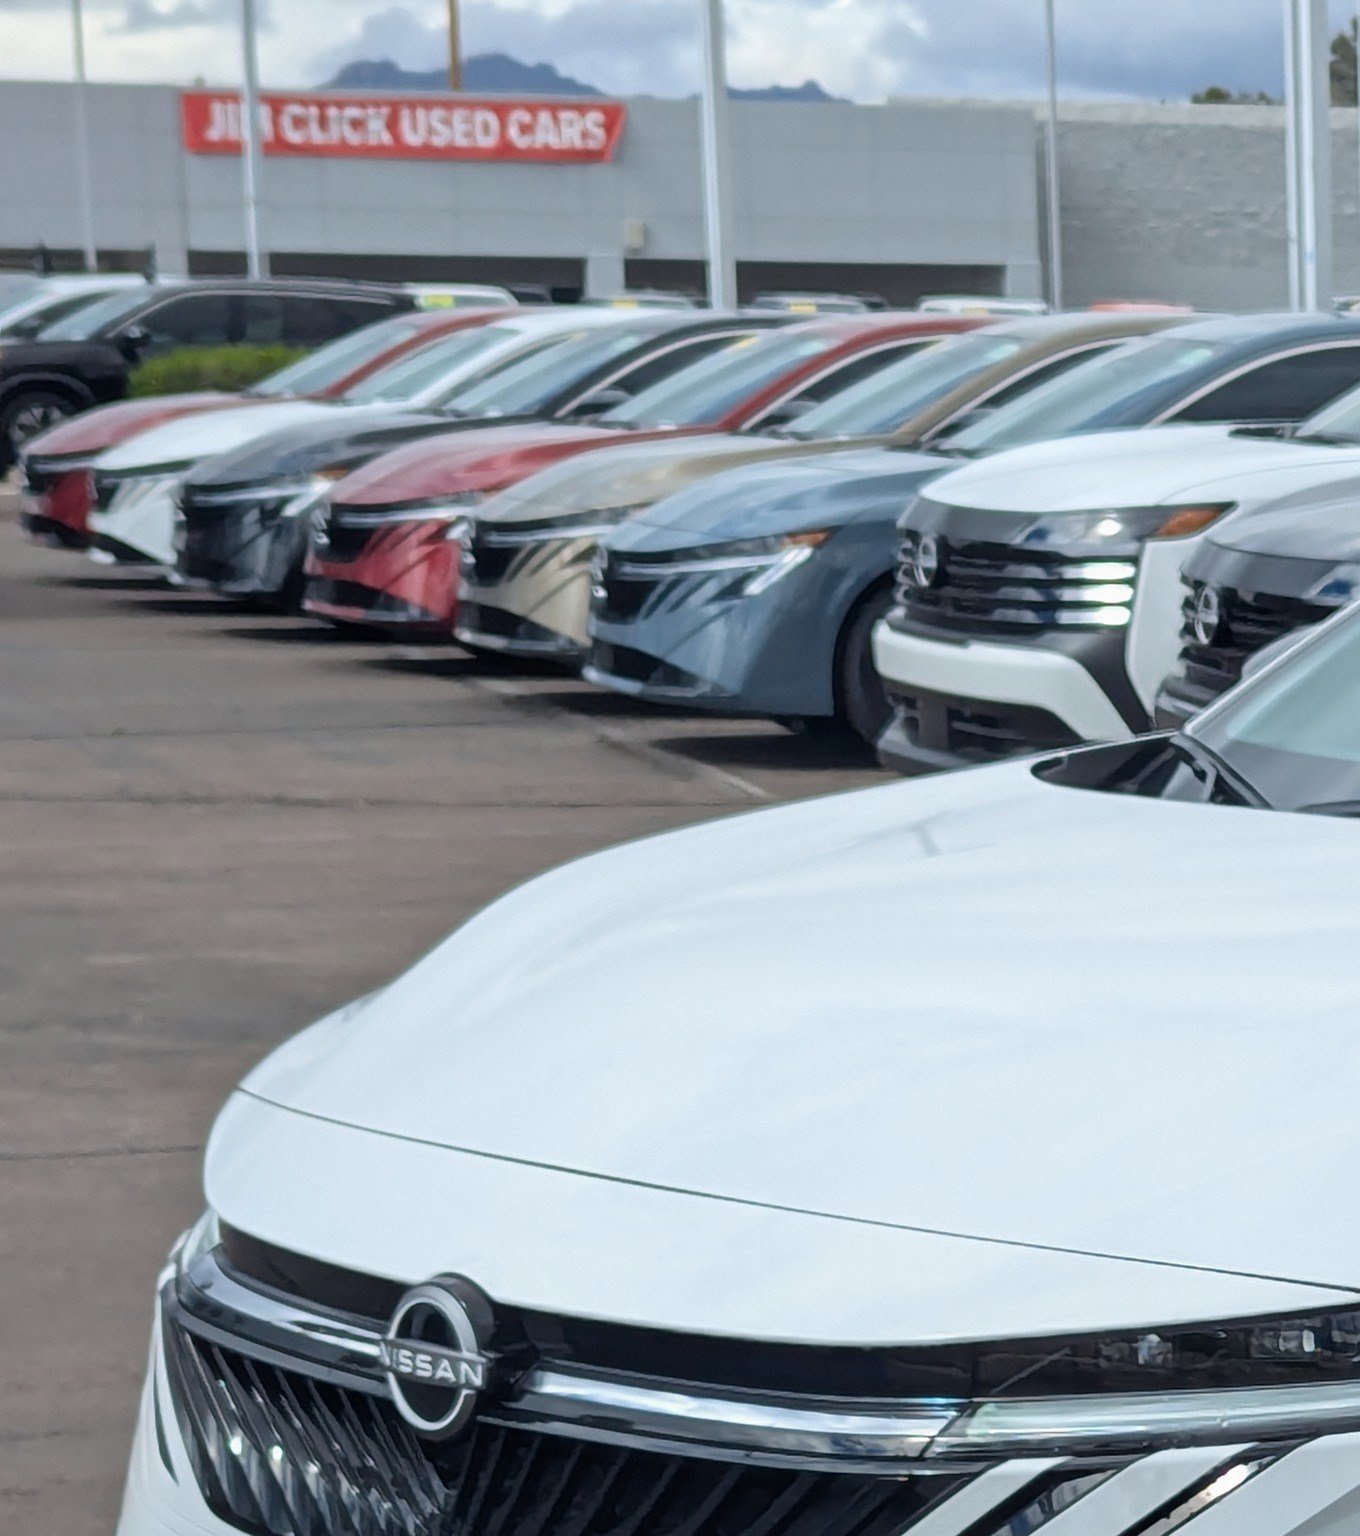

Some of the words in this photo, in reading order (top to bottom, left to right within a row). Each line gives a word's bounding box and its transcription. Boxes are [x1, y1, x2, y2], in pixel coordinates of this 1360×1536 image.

[280, 104, 396, 147] CLICK
[400, 108, 499, 149] USED
[507, 110, 608, 152] CARS
